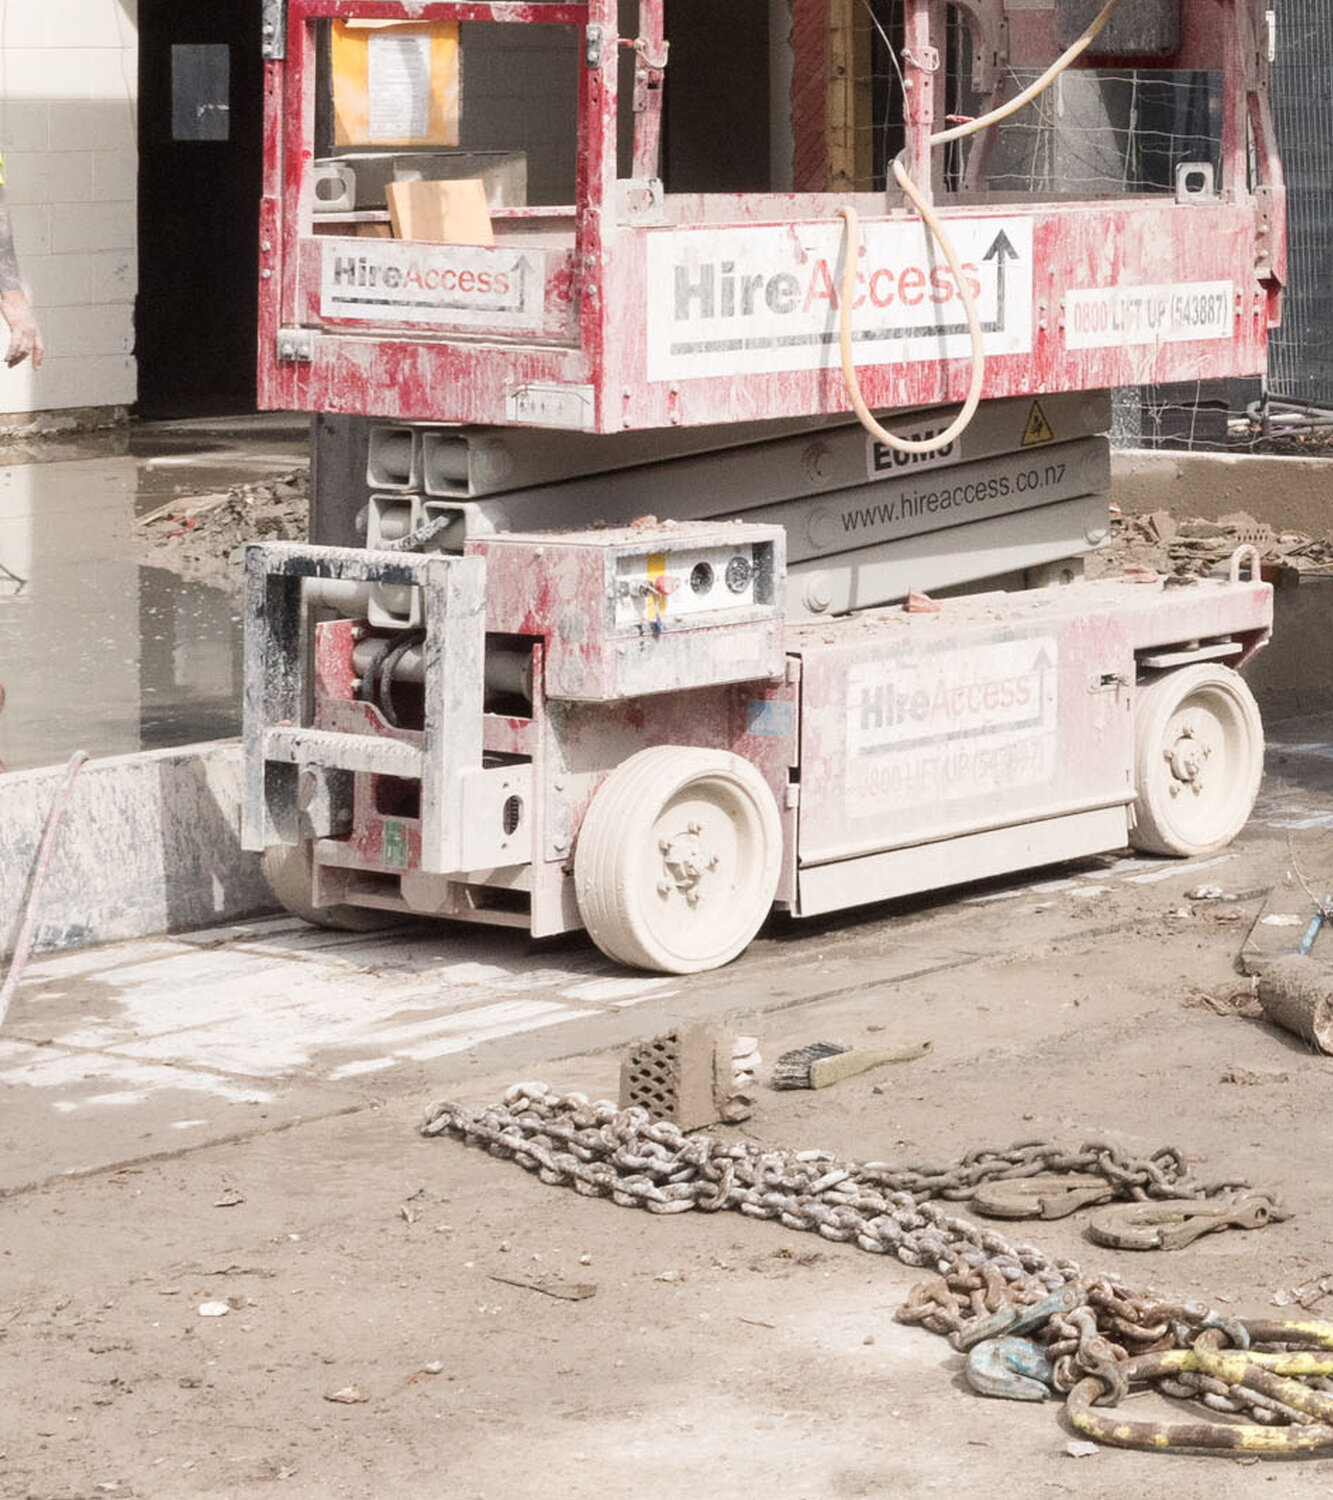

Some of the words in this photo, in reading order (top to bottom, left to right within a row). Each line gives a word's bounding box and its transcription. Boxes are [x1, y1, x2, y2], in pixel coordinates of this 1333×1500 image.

[334, 256, 510, 296] HireAccess
[1074, 301, 1108, 334] 0800
[1170, 290, 1229, 330] (543887)
[841, 463, 1066, 533] www.hireaccess.co.nz
